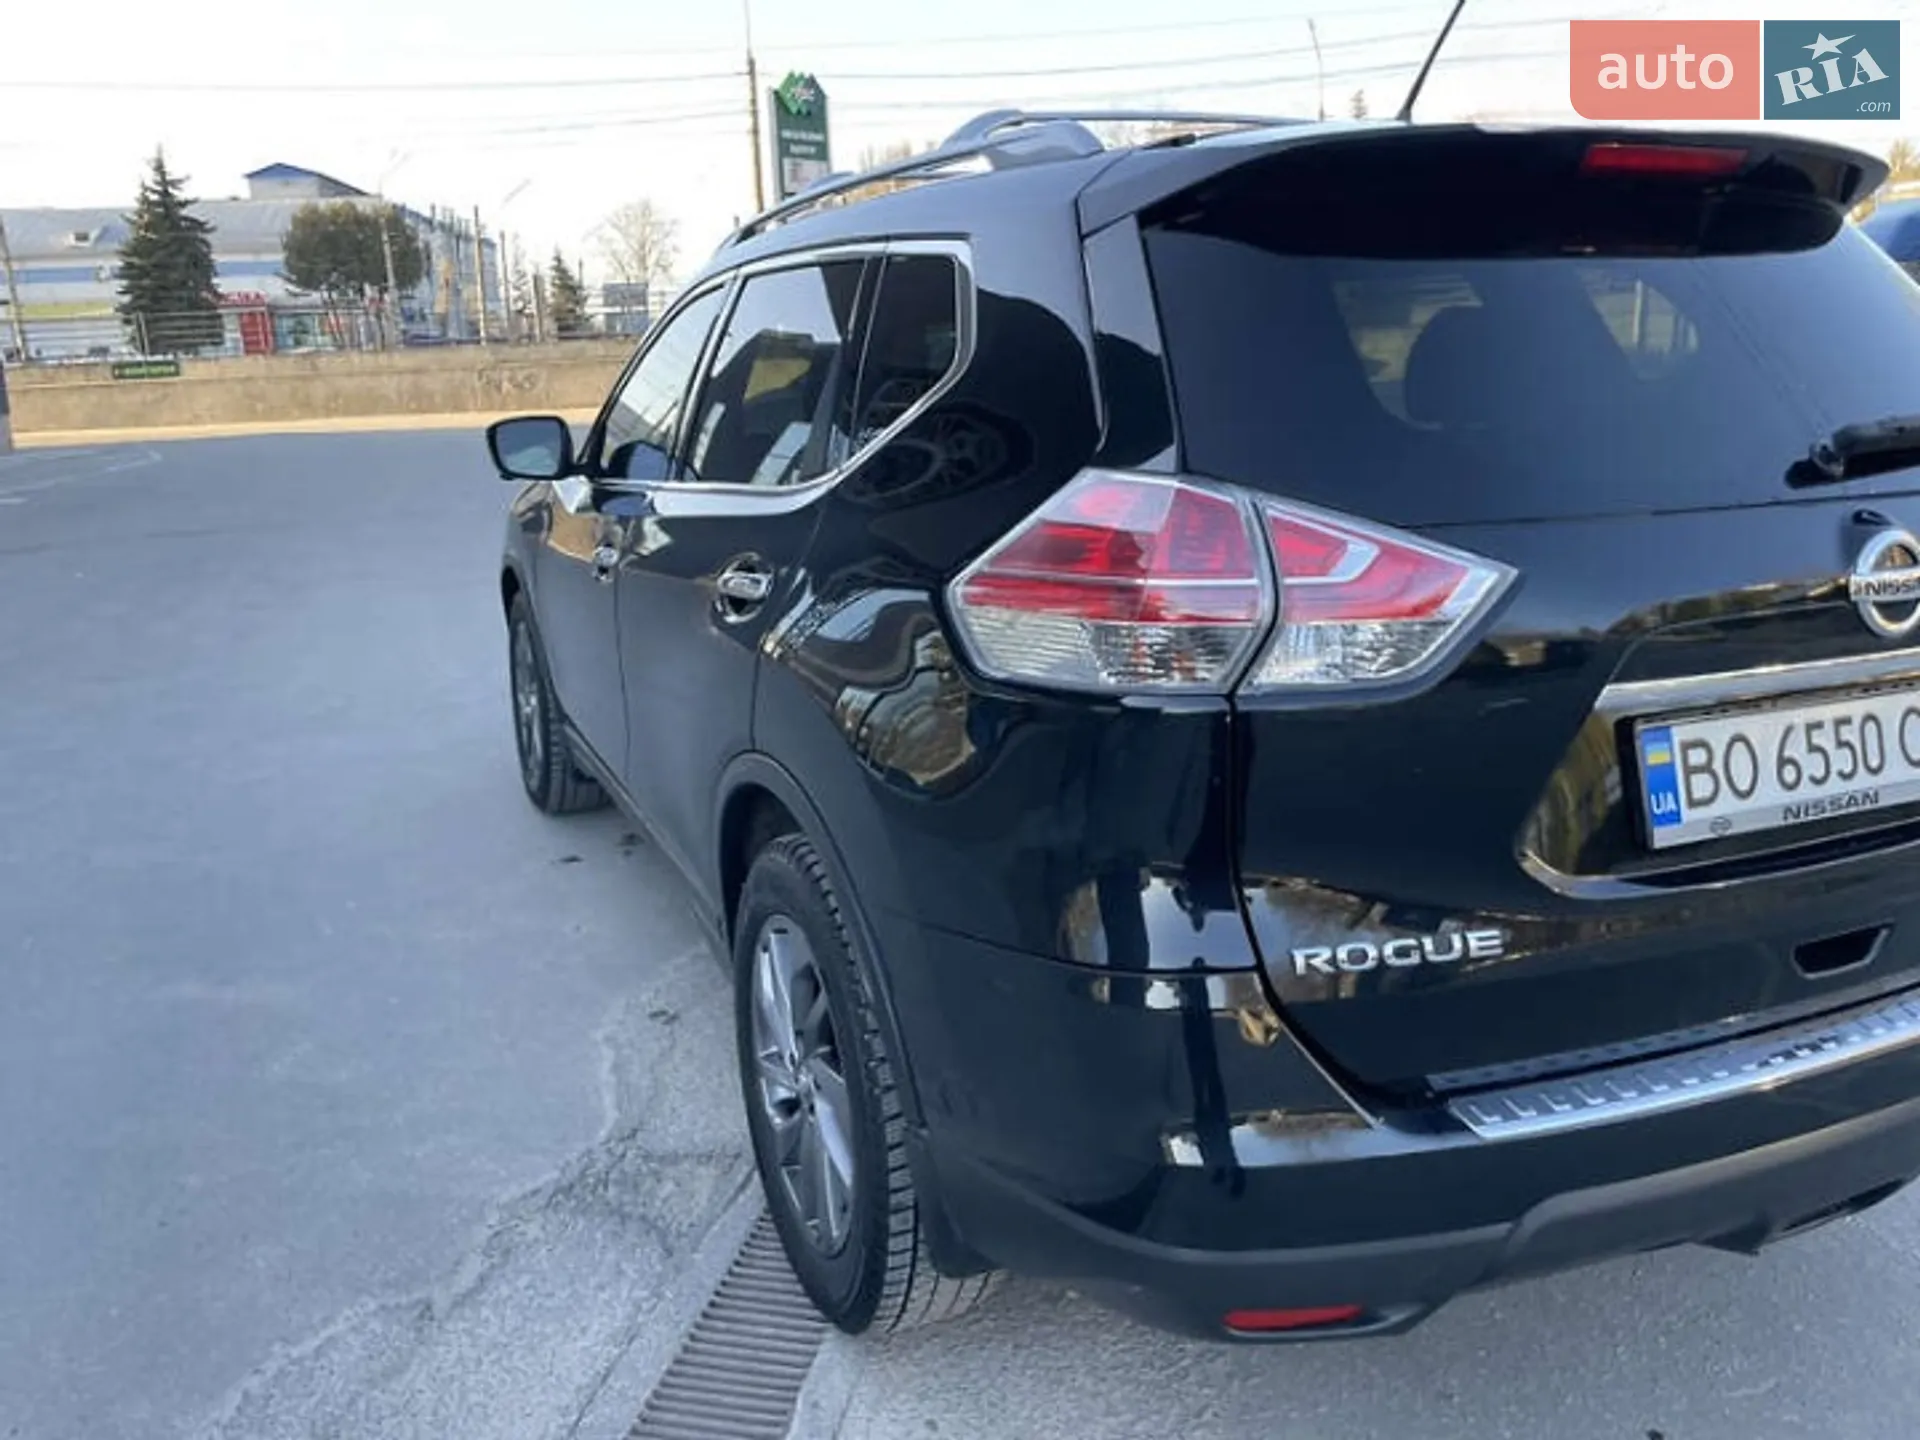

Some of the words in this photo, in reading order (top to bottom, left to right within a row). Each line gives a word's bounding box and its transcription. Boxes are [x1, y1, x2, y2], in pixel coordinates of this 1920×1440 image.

[1680, 733, 1760, 810] BO
[1775, 712, 1886, 793] 6550
[1651, 792, 1678, 815] UA
[1782, 789, 1880, 822] NISSAN
[1291, 928, 1505, 977] ROGUE
